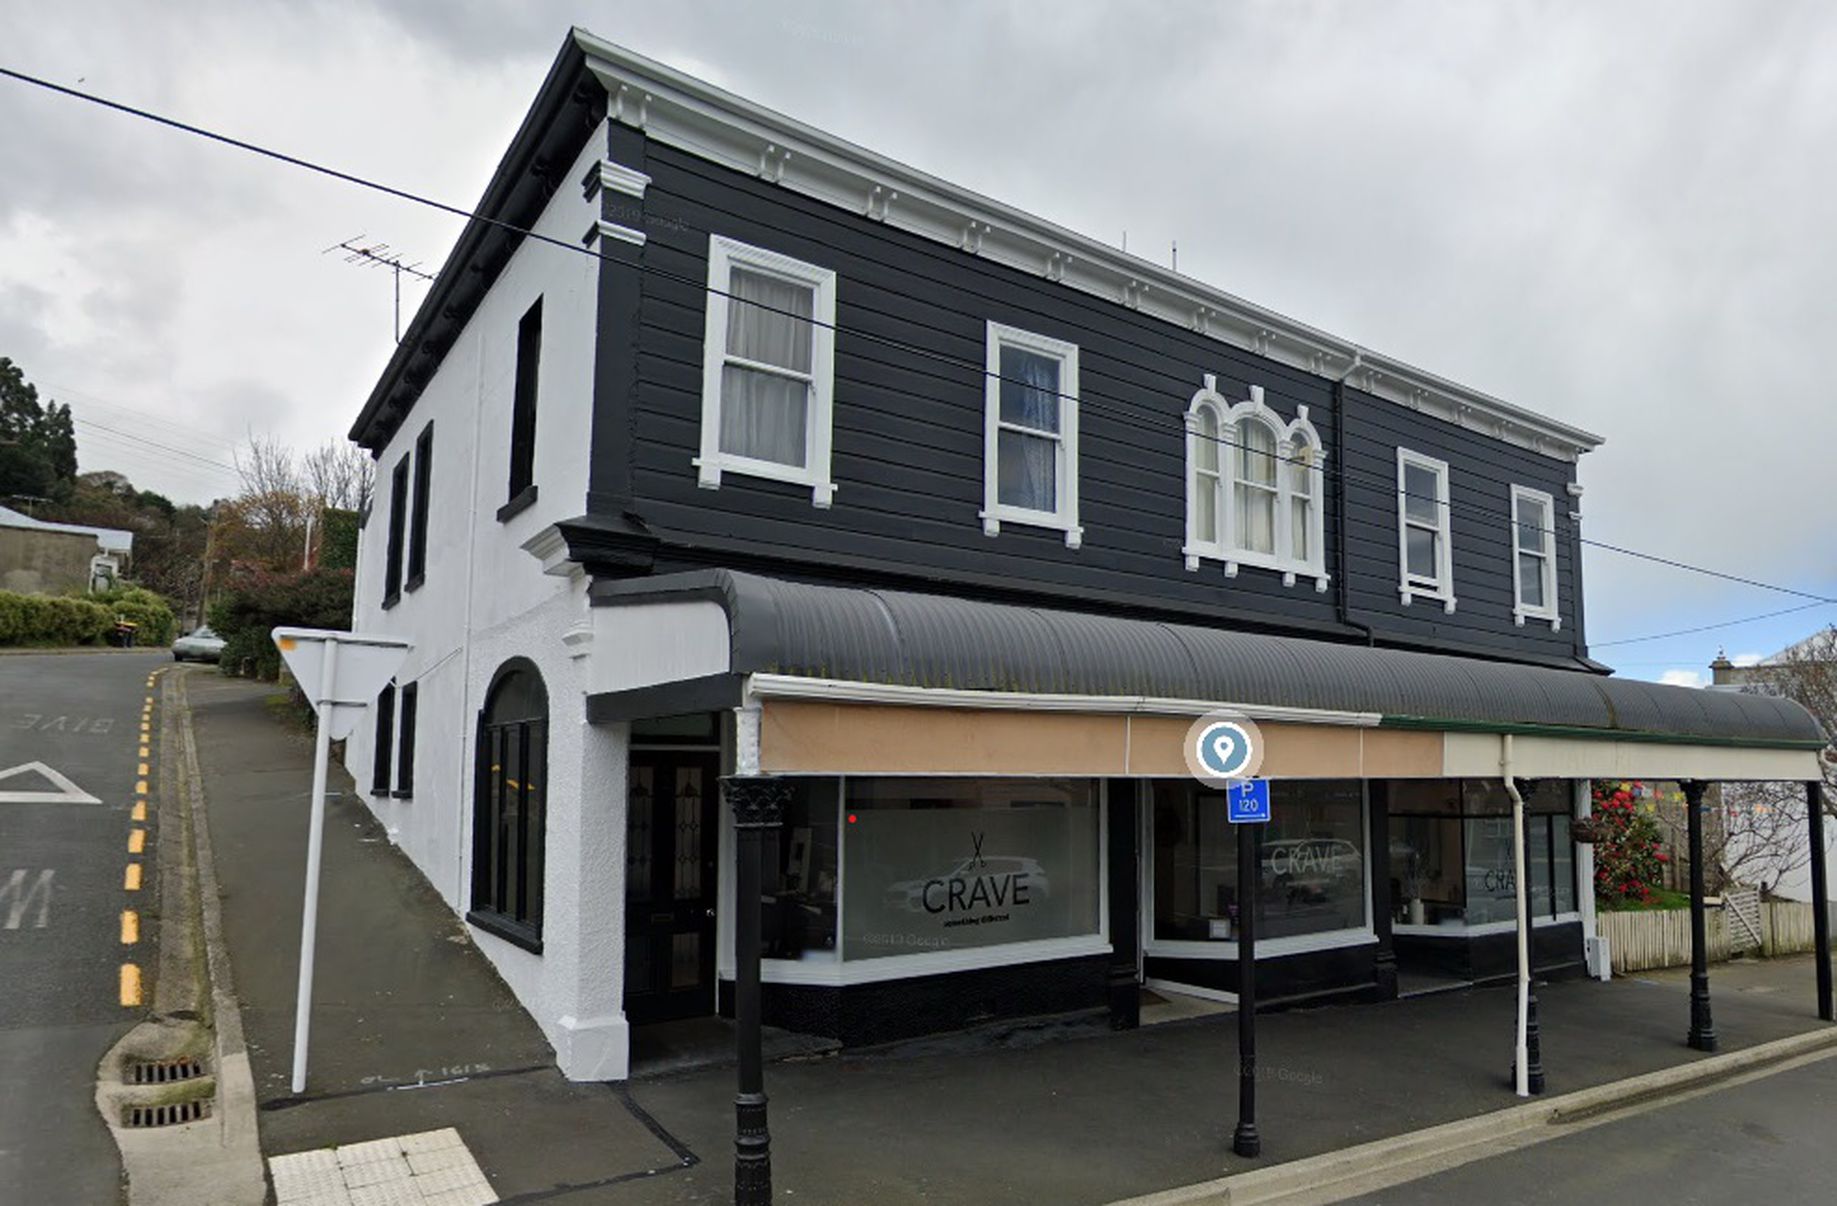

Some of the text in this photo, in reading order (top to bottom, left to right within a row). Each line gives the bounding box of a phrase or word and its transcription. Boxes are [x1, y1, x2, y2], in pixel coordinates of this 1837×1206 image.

[1241, 782, 1254, 798] P
[1239, 798, 1259, 813] 120
[1271, 847, 1344, 876] CRAVE
[1484, 869, 1516, 892] CRA
[922, 873, 1030, 914] CRAVE
